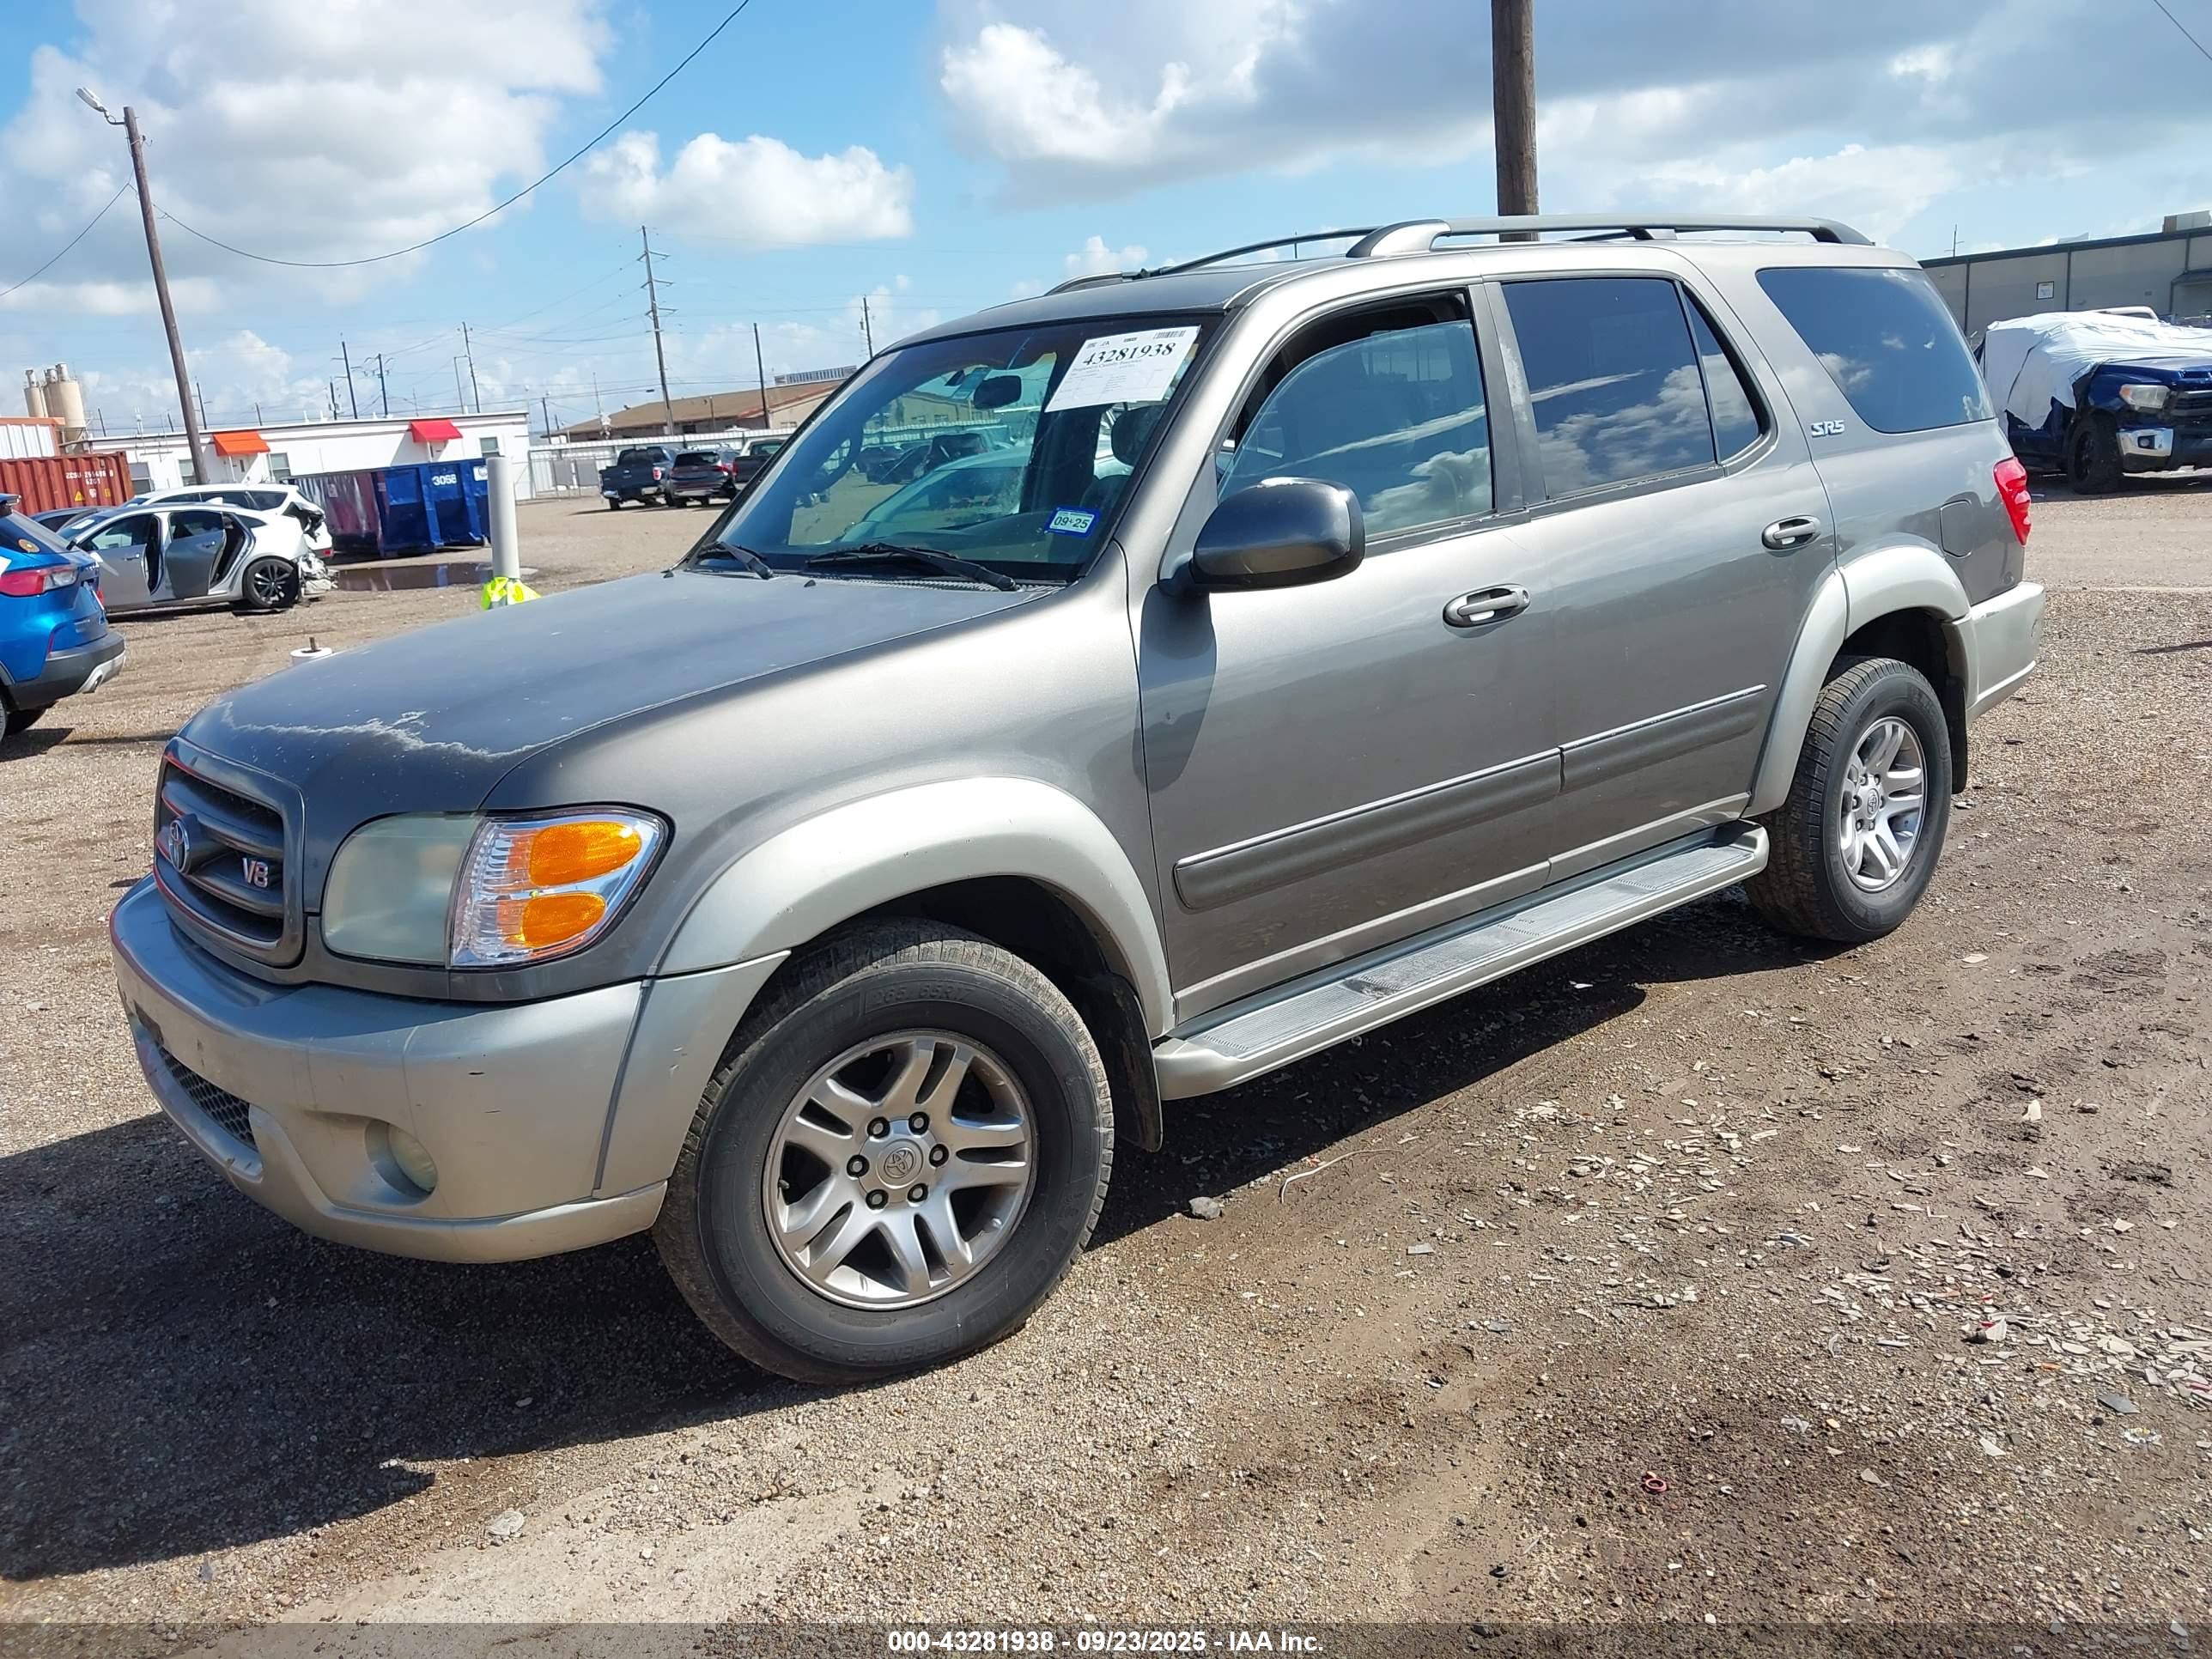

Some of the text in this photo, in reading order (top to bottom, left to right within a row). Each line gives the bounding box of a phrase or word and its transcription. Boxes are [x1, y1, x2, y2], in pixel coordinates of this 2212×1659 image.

[1083, 342, 1176, 367] 43281938
[1811, 420, 1845, 438] SR5
[1054, 516, 1091, 529] 09 25
[242, 857, 269, 888] V8
